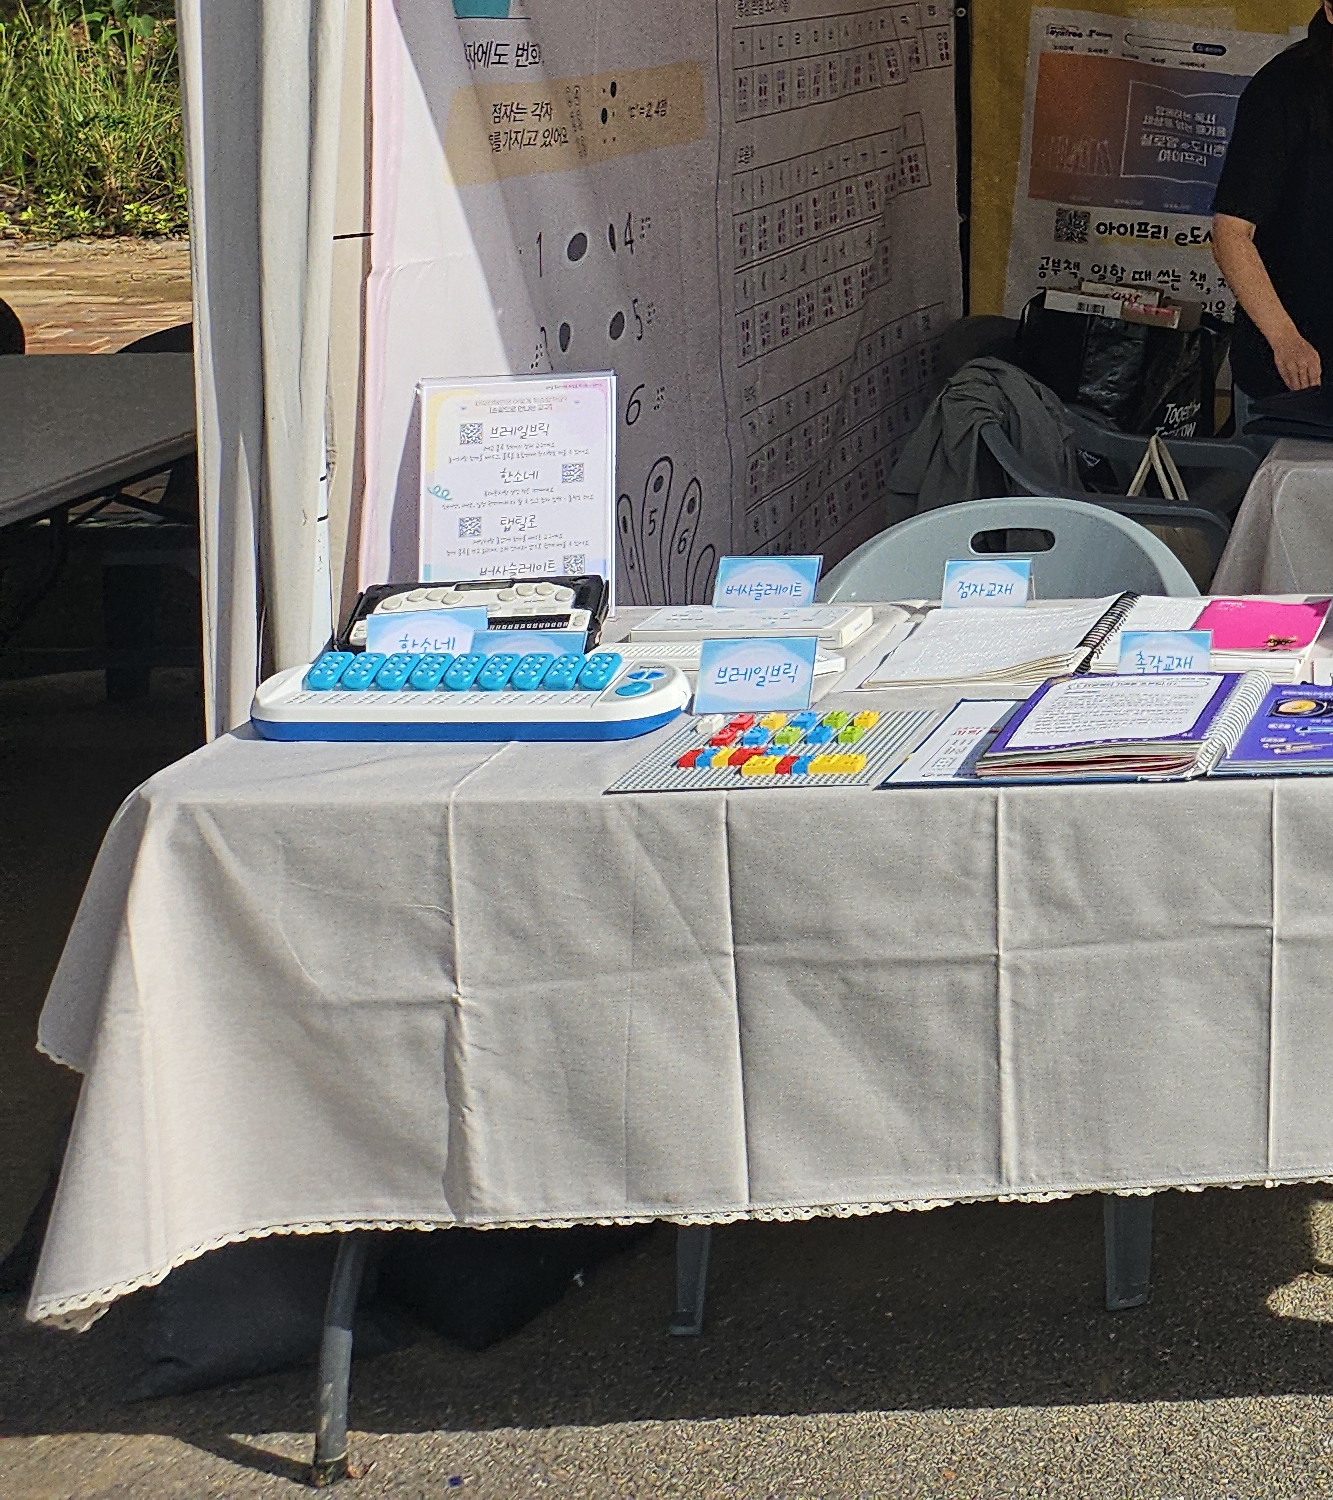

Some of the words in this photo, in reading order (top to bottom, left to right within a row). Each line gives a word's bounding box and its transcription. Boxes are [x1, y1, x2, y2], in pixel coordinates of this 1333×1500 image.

[1096, 221, 1169, 240] 아이프리
[1132, 270, 1151, 281] 때
[625, 384, 645, 426] 6
[490, 422, 550, 439] 브레일브릭
[500, 467, 539, 484] 한소네
[480, 559, 557, 577] 버사슬레이트
[725, 581, 804, 601] 버사슬레이트
[956, 580, 1015, 598] 점자교재
[1135, 649, 1194, 672] 촉각교재
[714, 662, 801, 688] 브레일브릭
